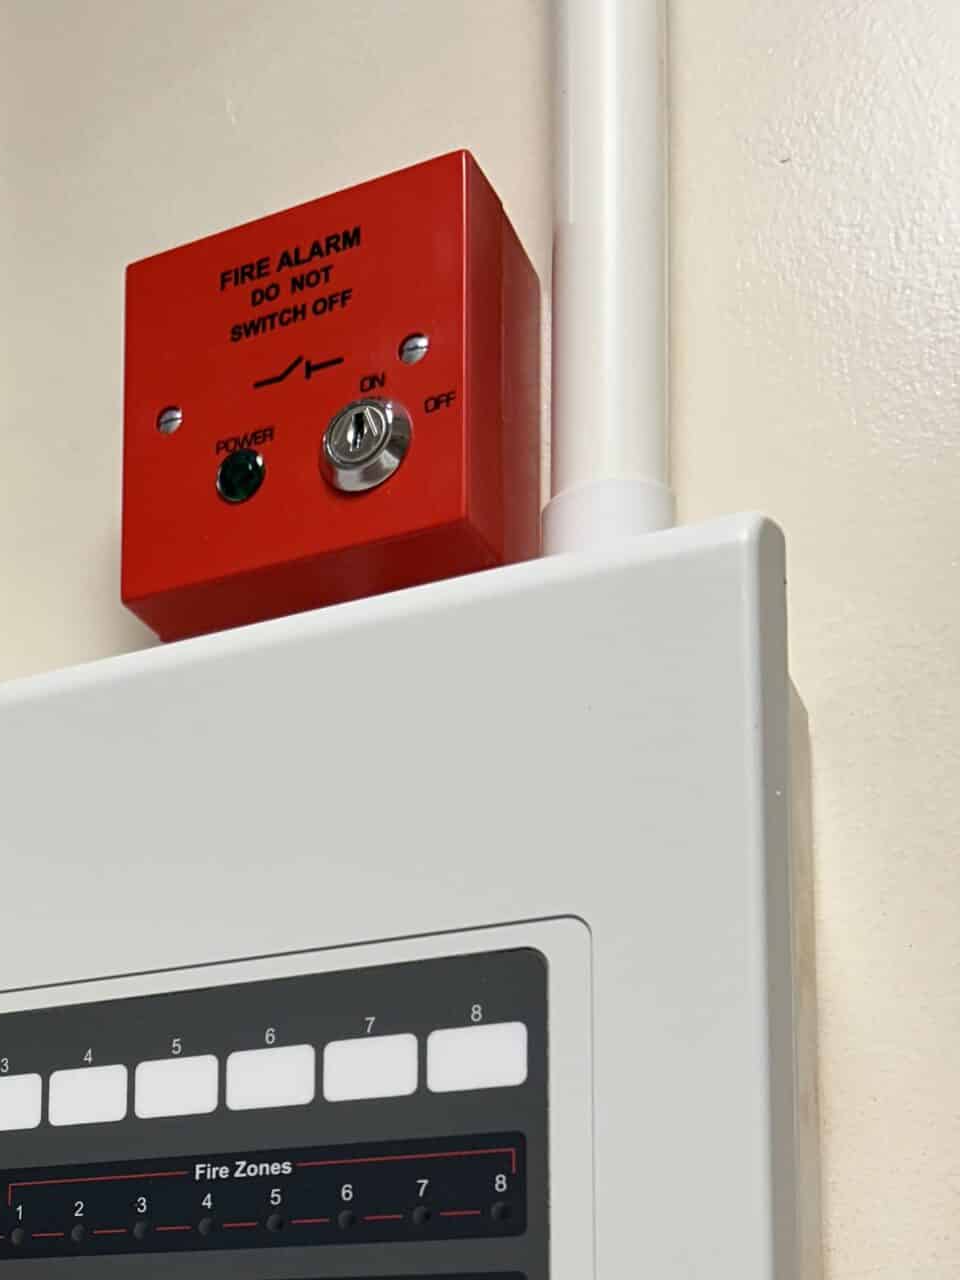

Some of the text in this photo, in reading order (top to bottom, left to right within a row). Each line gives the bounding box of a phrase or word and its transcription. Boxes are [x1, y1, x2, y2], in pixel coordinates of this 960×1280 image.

[220, 226, 361, 290] FIRE ALARM
[251, 265, 333, 307] DO NOT
[230, 289, 353, 342] SWITCH OFF
[360, 372, 385, 392] ON
[424, 392, 456, 413] OFF
[216, 428, 274, 453] POWER
[1, 1058, 9, 1073] 3
[84, 1049, 93, 1064] 4
[172, 1039, 181, 1055] 5
[265, 1028, 275, 1044] 6
[365, 1017, 375, 1033] 7
[471, 1005, 481, 1022] 8
[195, 1160, 292, 1180] Fire Zones
[16, 1174, 507, 1220] 1 2 3 4 5 6 7 8
